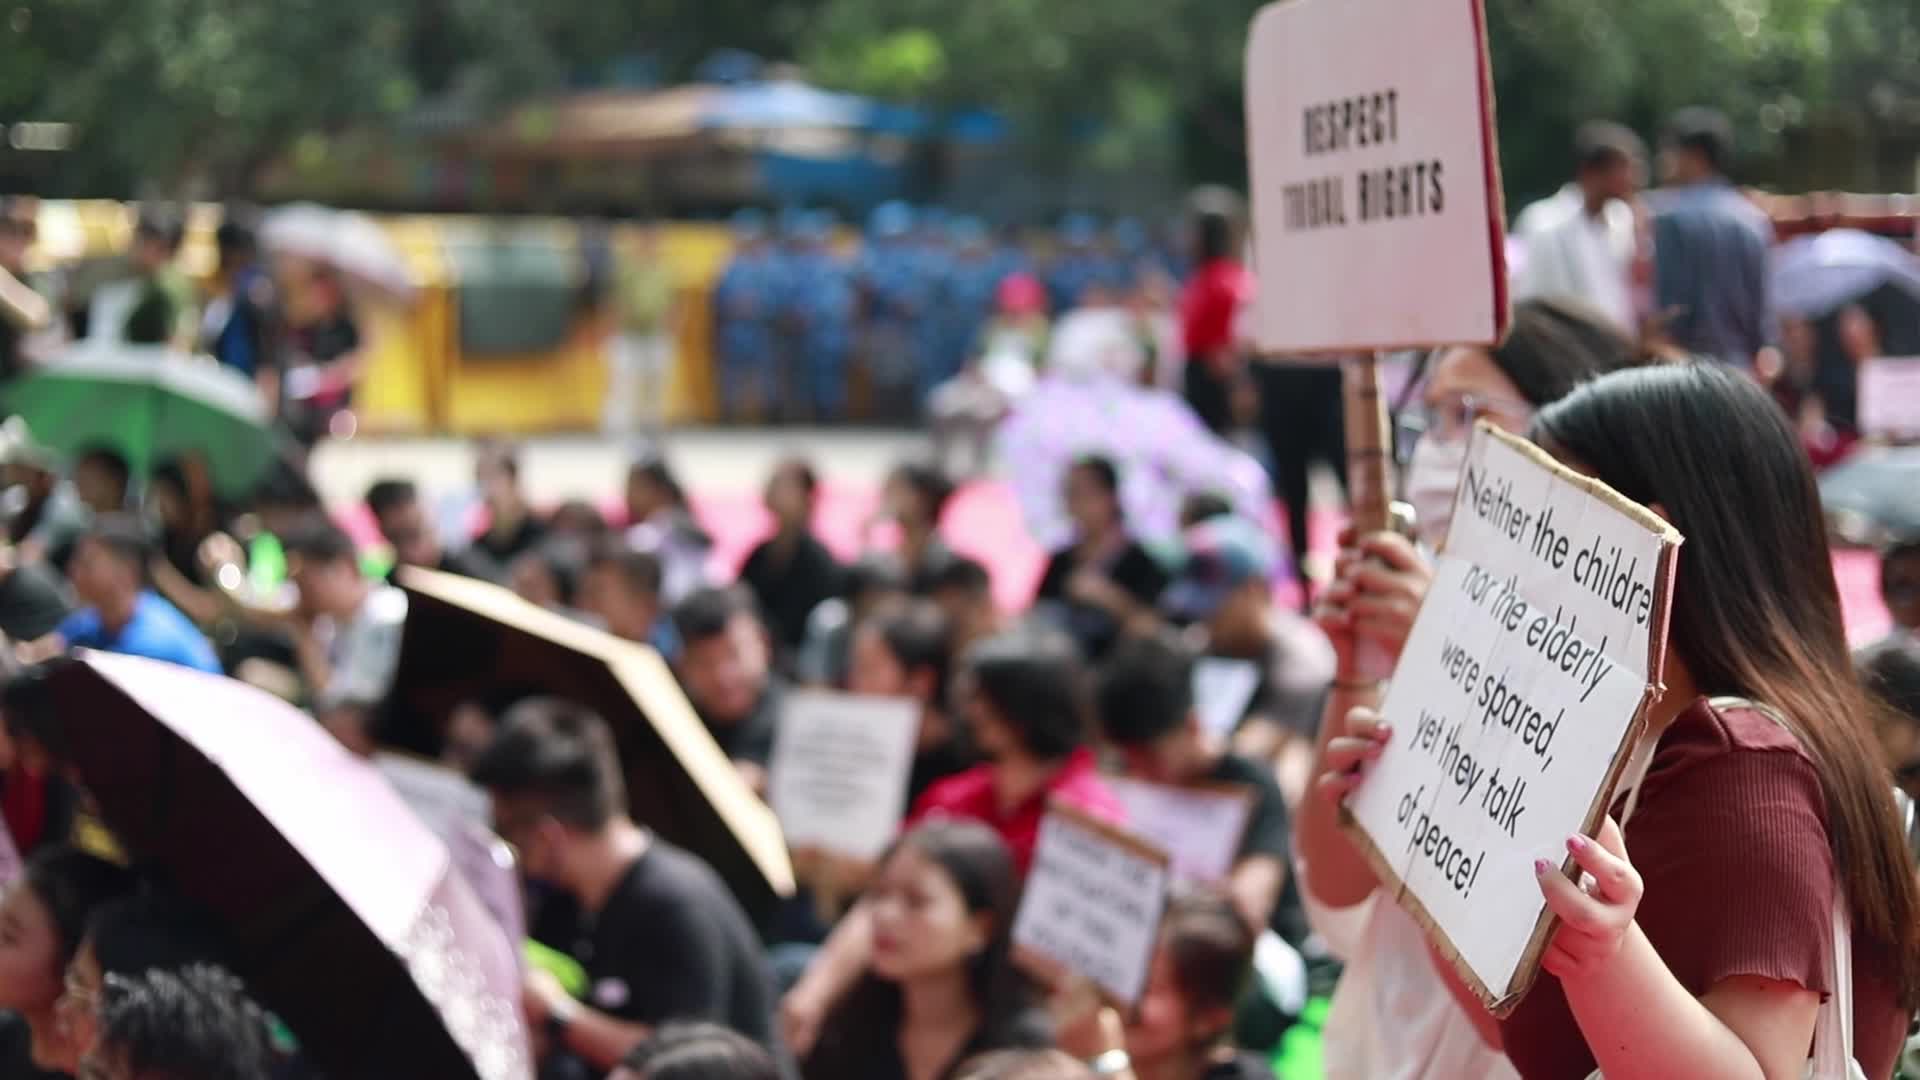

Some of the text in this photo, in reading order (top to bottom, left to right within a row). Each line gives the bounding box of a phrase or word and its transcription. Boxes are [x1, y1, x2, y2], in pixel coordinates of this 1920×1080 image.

[1304, 88, 1398, 156] RESPECT
[1358, 159, 1444, 222] RIGHTS
[1464, 466, 1532, 544] Neither
[1531, 507, 1569, 569] the
[1461, 564, 1613, 703] nor the elderly
[1440, 635, 1566, 773] were spared,
[1408, 708, 1526, 838] yet they talk
[1398, 785, 1486, 899] of peace!
